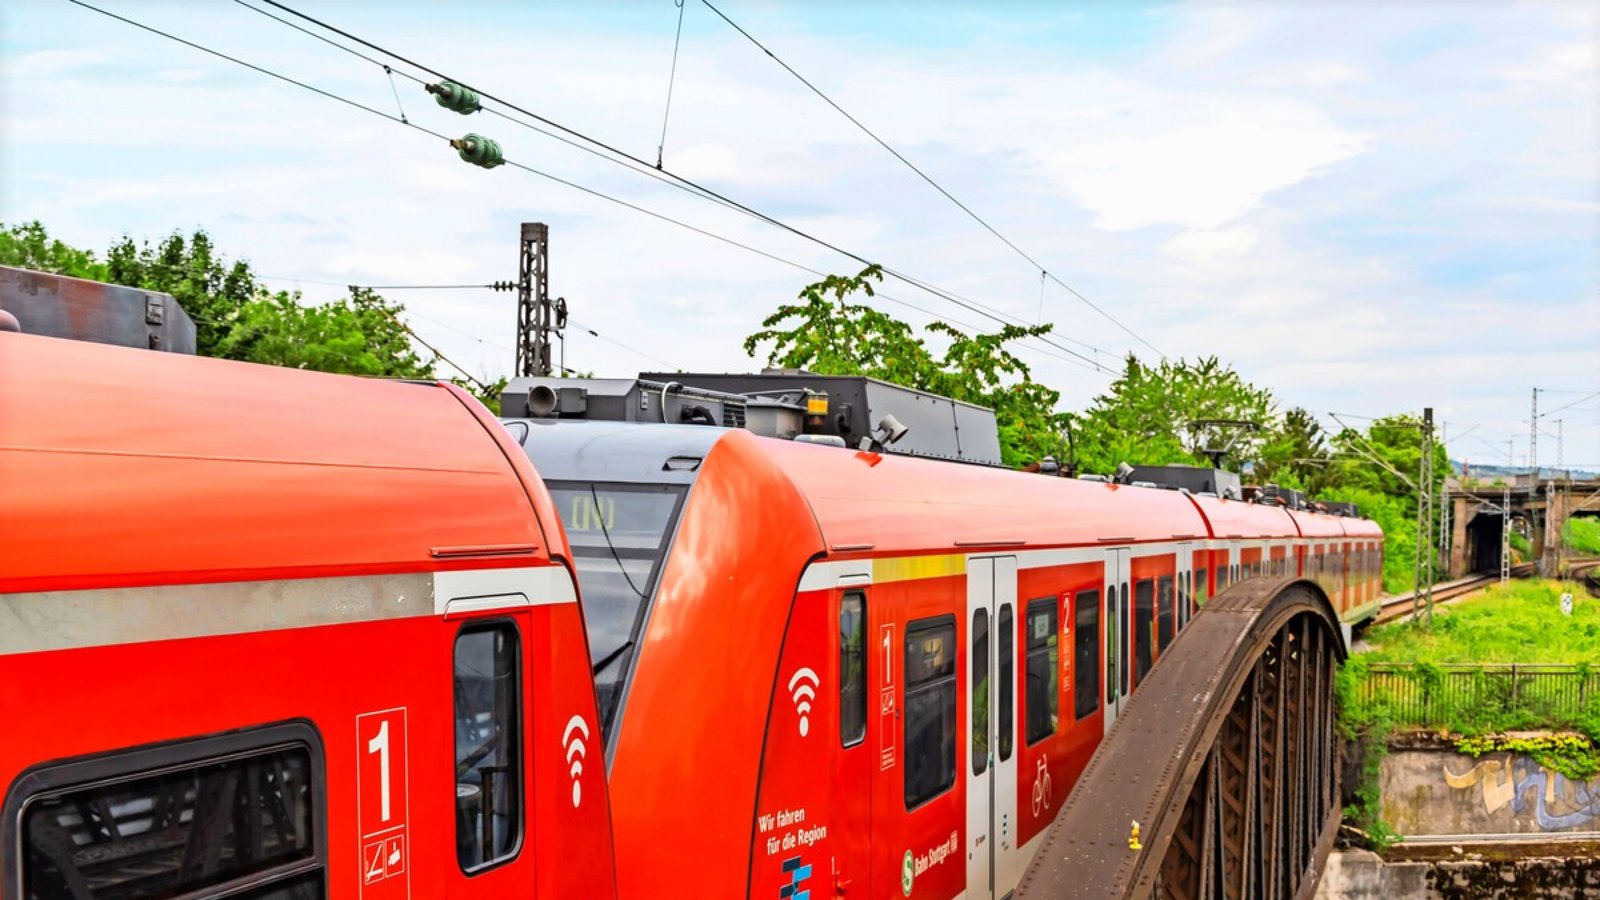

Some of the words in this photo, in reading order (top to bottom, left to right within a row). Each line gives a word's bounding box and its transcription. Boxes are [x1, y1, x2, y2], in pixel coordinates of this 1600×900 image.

[1063, 597, 1070, 634] 2
[883, 629, 891, 684] 1
[368, 720, 391, 822] 1
[759, 814, 774, 833] Wir
[777, 808, 805, 828] fahren
[767, 837, 780, 856] für
[782, 832, 796, 851] die
[797, 824, 827, 847] Region
[903, 852, 913, 893] S
